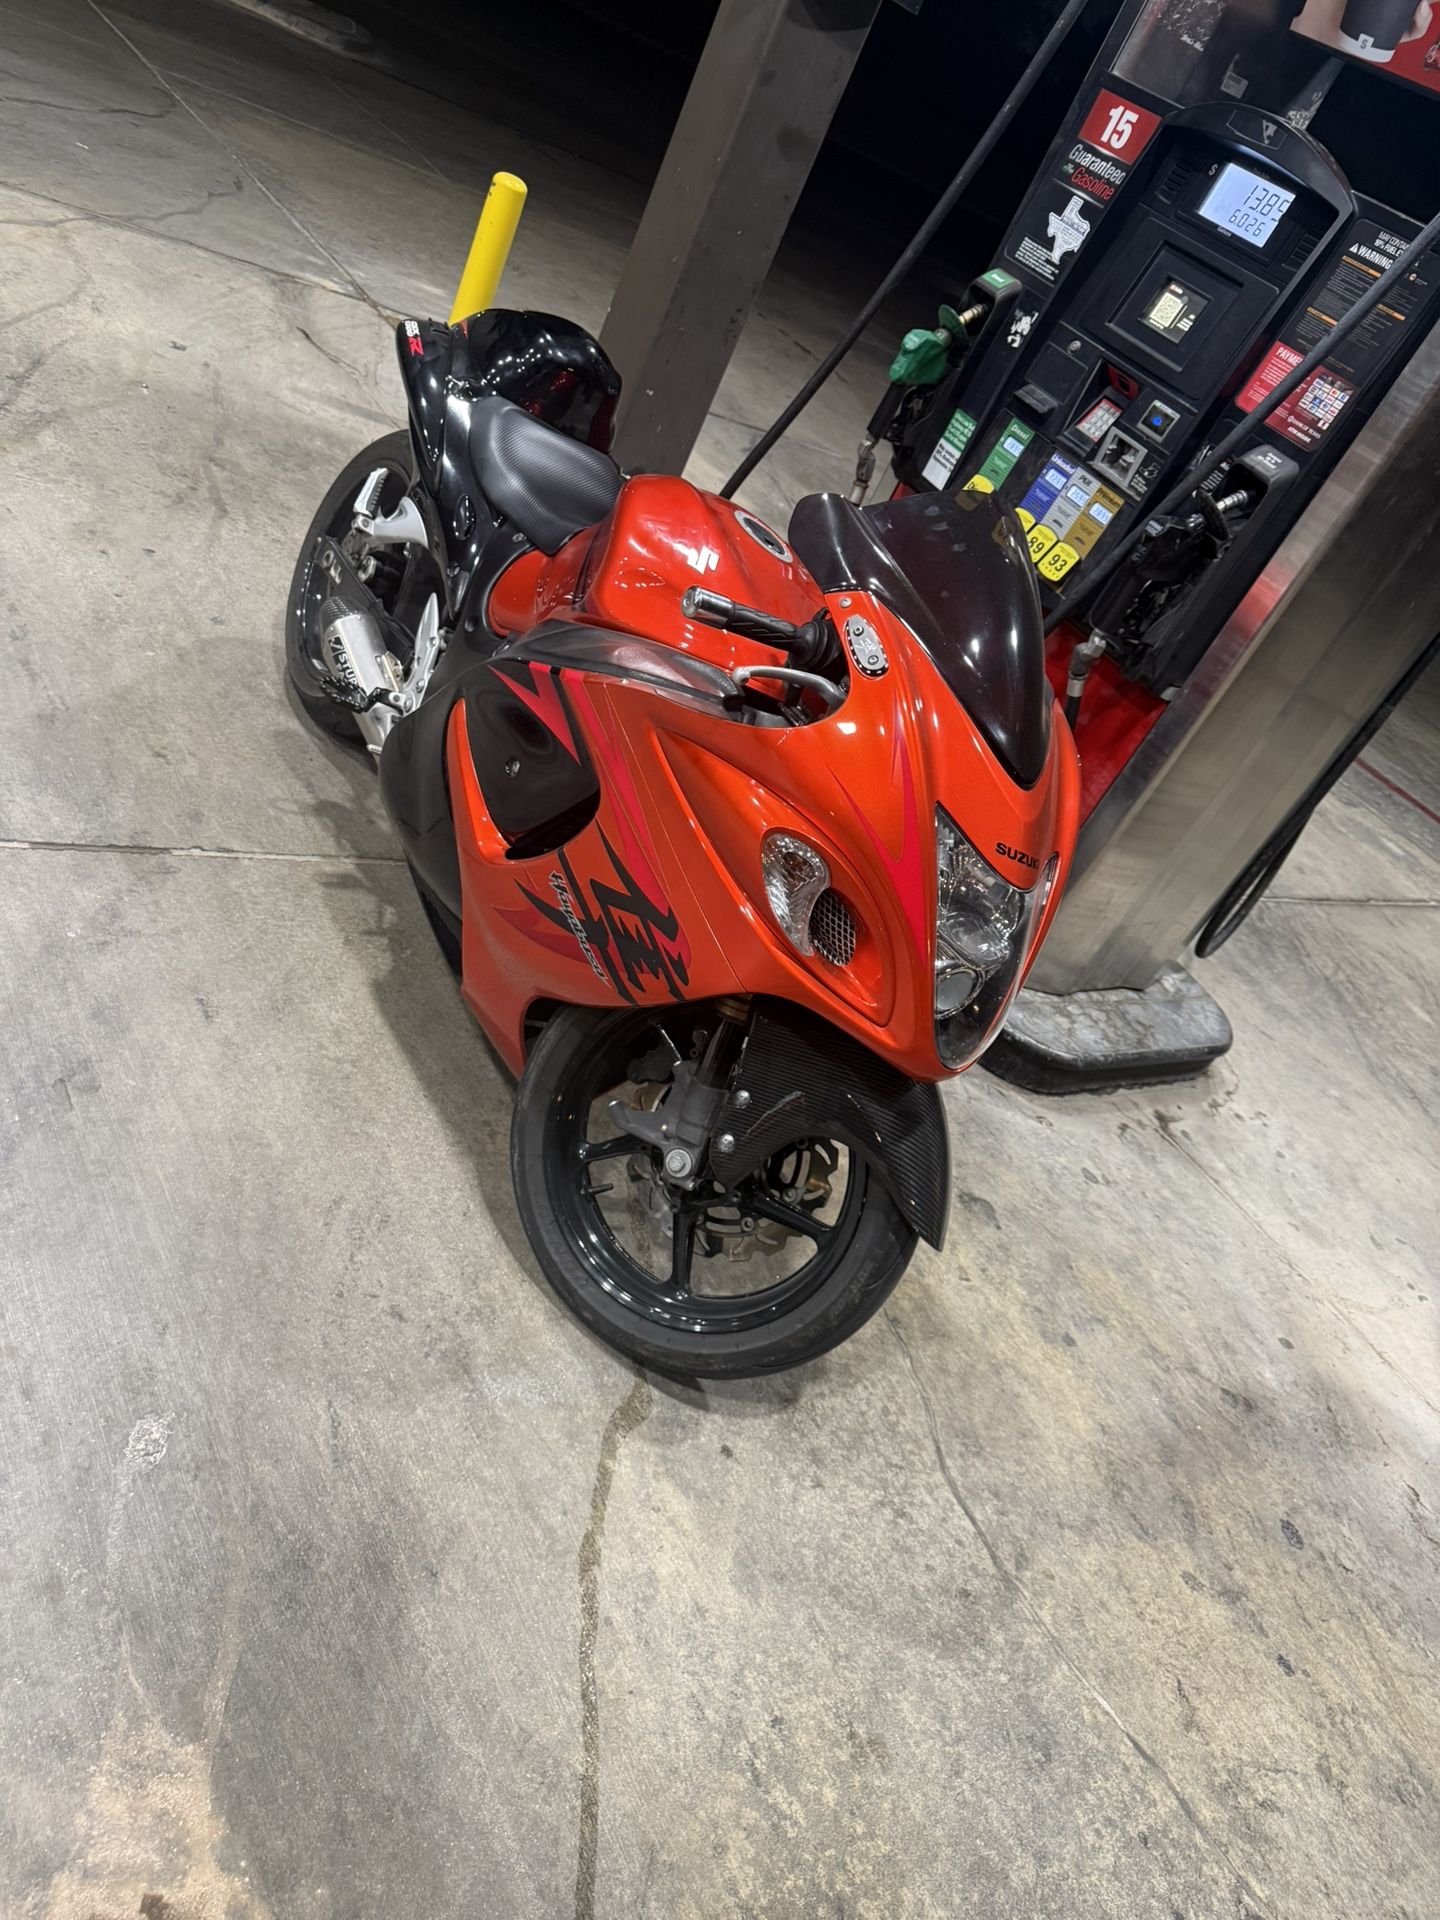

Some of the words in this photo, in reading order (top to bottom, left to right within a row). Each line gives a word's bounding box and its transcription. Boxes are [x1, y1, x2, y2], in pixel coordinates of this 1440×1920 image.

[1100, 105, 1139, 149] 15
[1071, 166, 1115, 200] Gasoline
[1228, 208, 1266, 237] 6.026
[1357, 245, 1394, 270] WARNING
[1384, 243, 1398, 256] FUEL
[1050, 452, 1078, 475] Unleaded
[1079, 474, 1094, 487] Plus
[1028, 536, 1045, 554] 89
[1048, 553, 1068, 572] 93
[549, 869, 613, 989] Hayabusa
